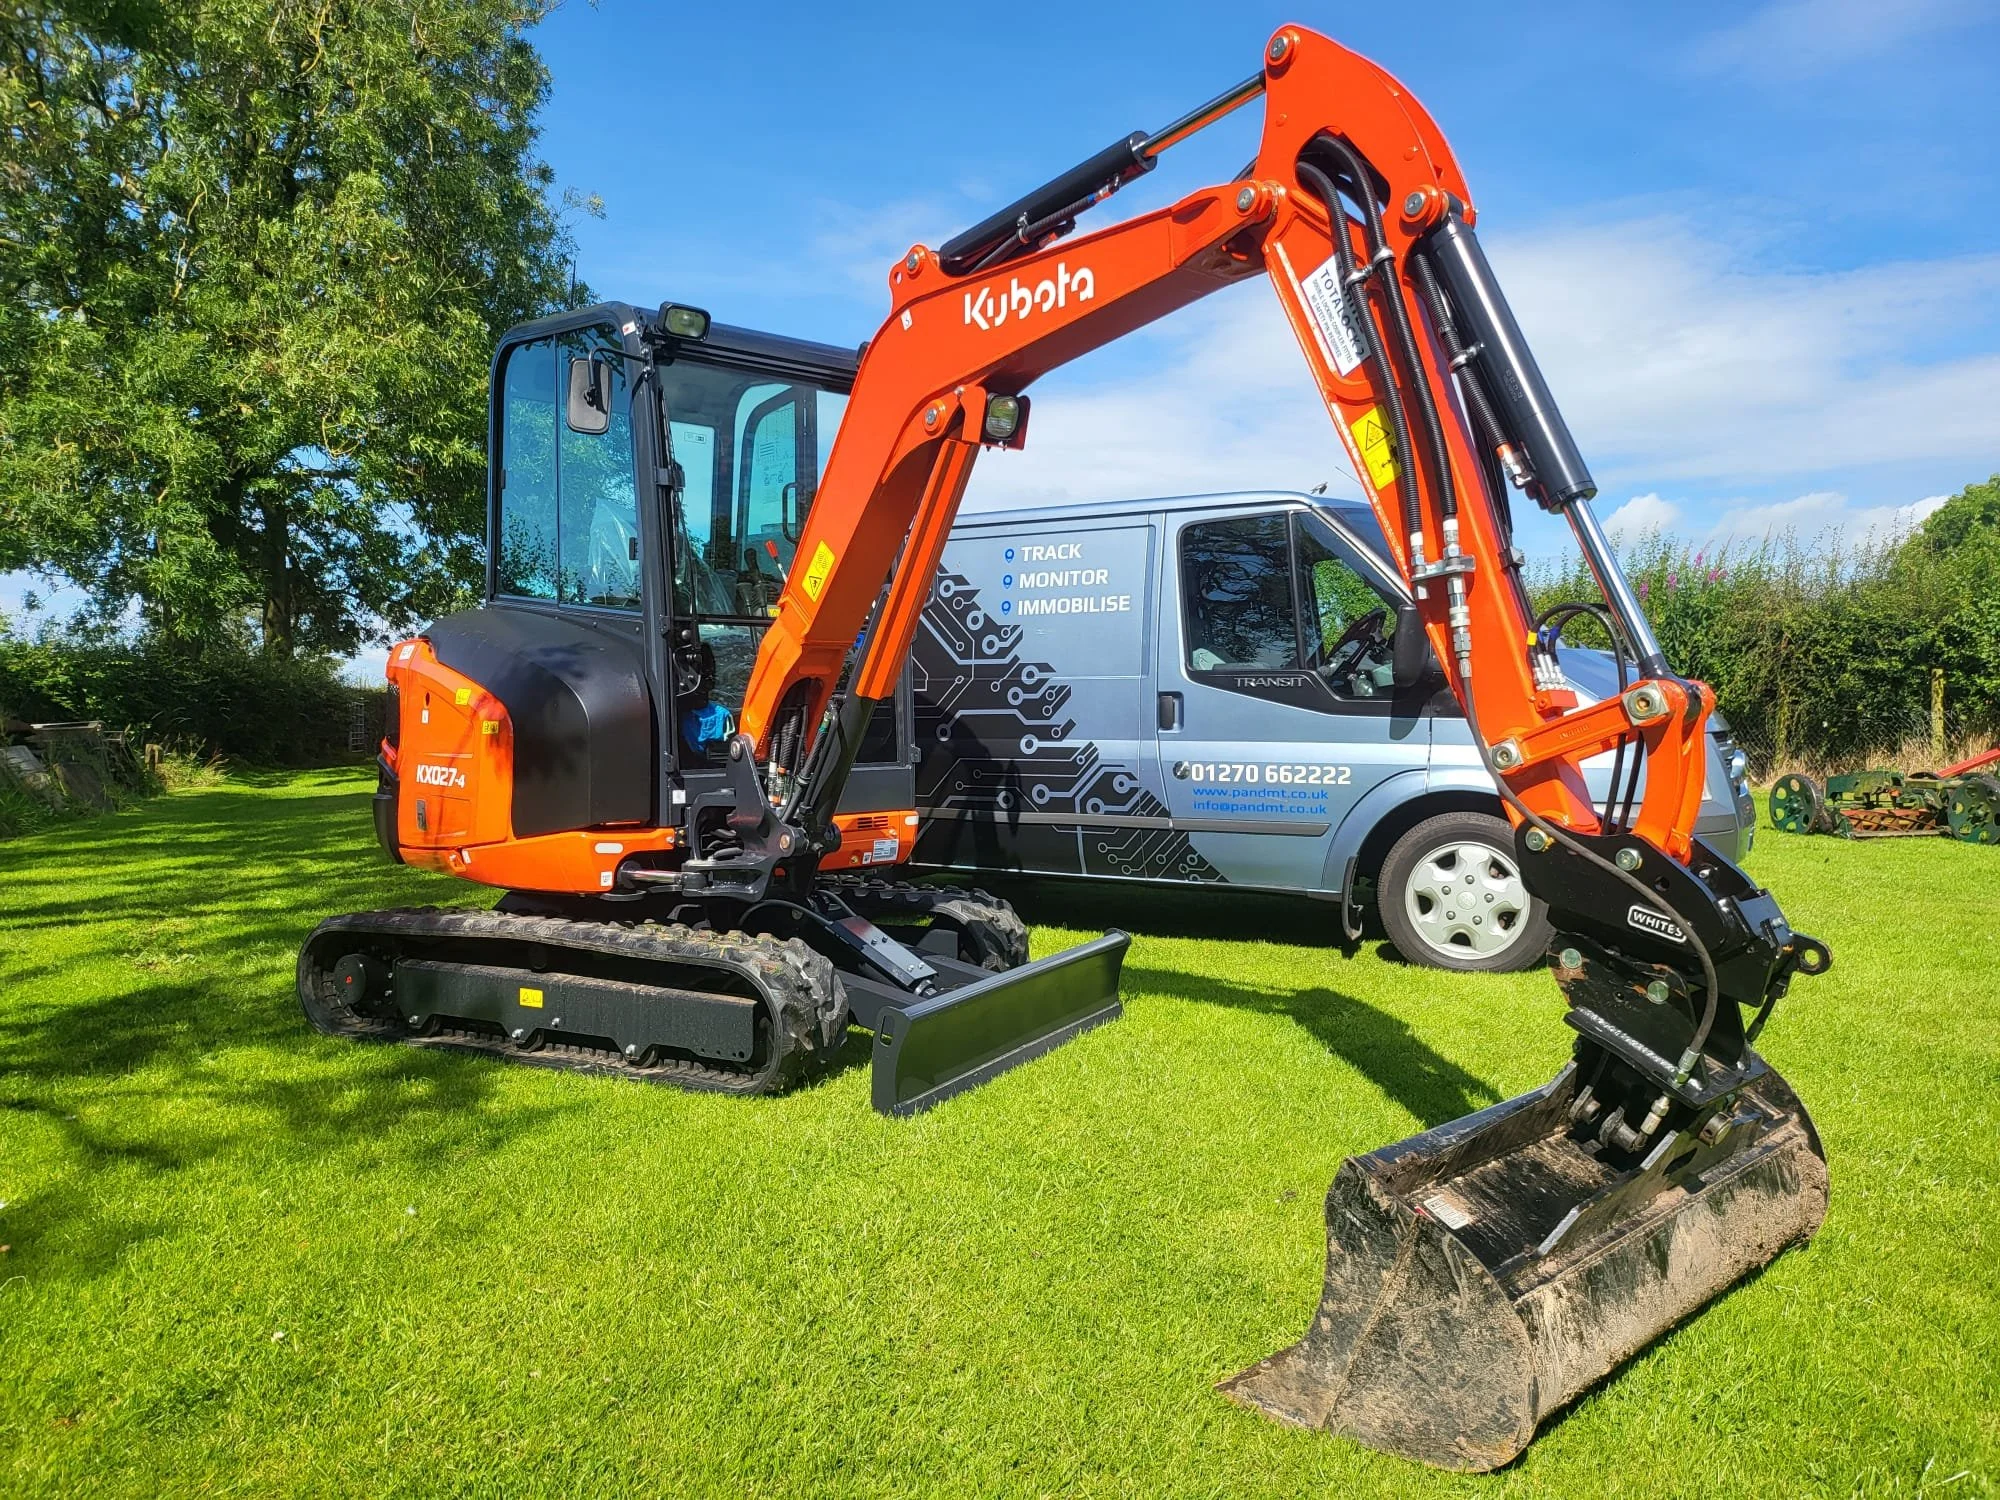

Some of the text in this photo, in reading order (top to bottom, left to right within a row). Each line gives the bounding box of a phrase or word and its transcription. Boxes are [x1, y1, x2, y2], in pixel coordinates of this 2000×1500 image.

[964, 262, 1095, 331] Kubota
[1314, 301, 1326, 321] SAFETY
[1320, 267, 1360, 348] TOTALOCK
[1321, 298, 1334, 321] LOCKING
[1341, 344, 1353, 363] FITTED
[1021, 543, 1082, 561] TRACK
[1019, 568, 1109, 589] MONITOR
[1018, 595, 1131, 616] IMMOBILISE
[1234, 677, 1305, 688] TRANSIT
[1191, 763, 1352, 785] 01270 662222
[1193, 786, 1329, 800] www.pandmt.co.uk
[1193, 801, 1327, 815] info@pandmt.co.uk
[1633, 911, 1683, 937] WHITES
